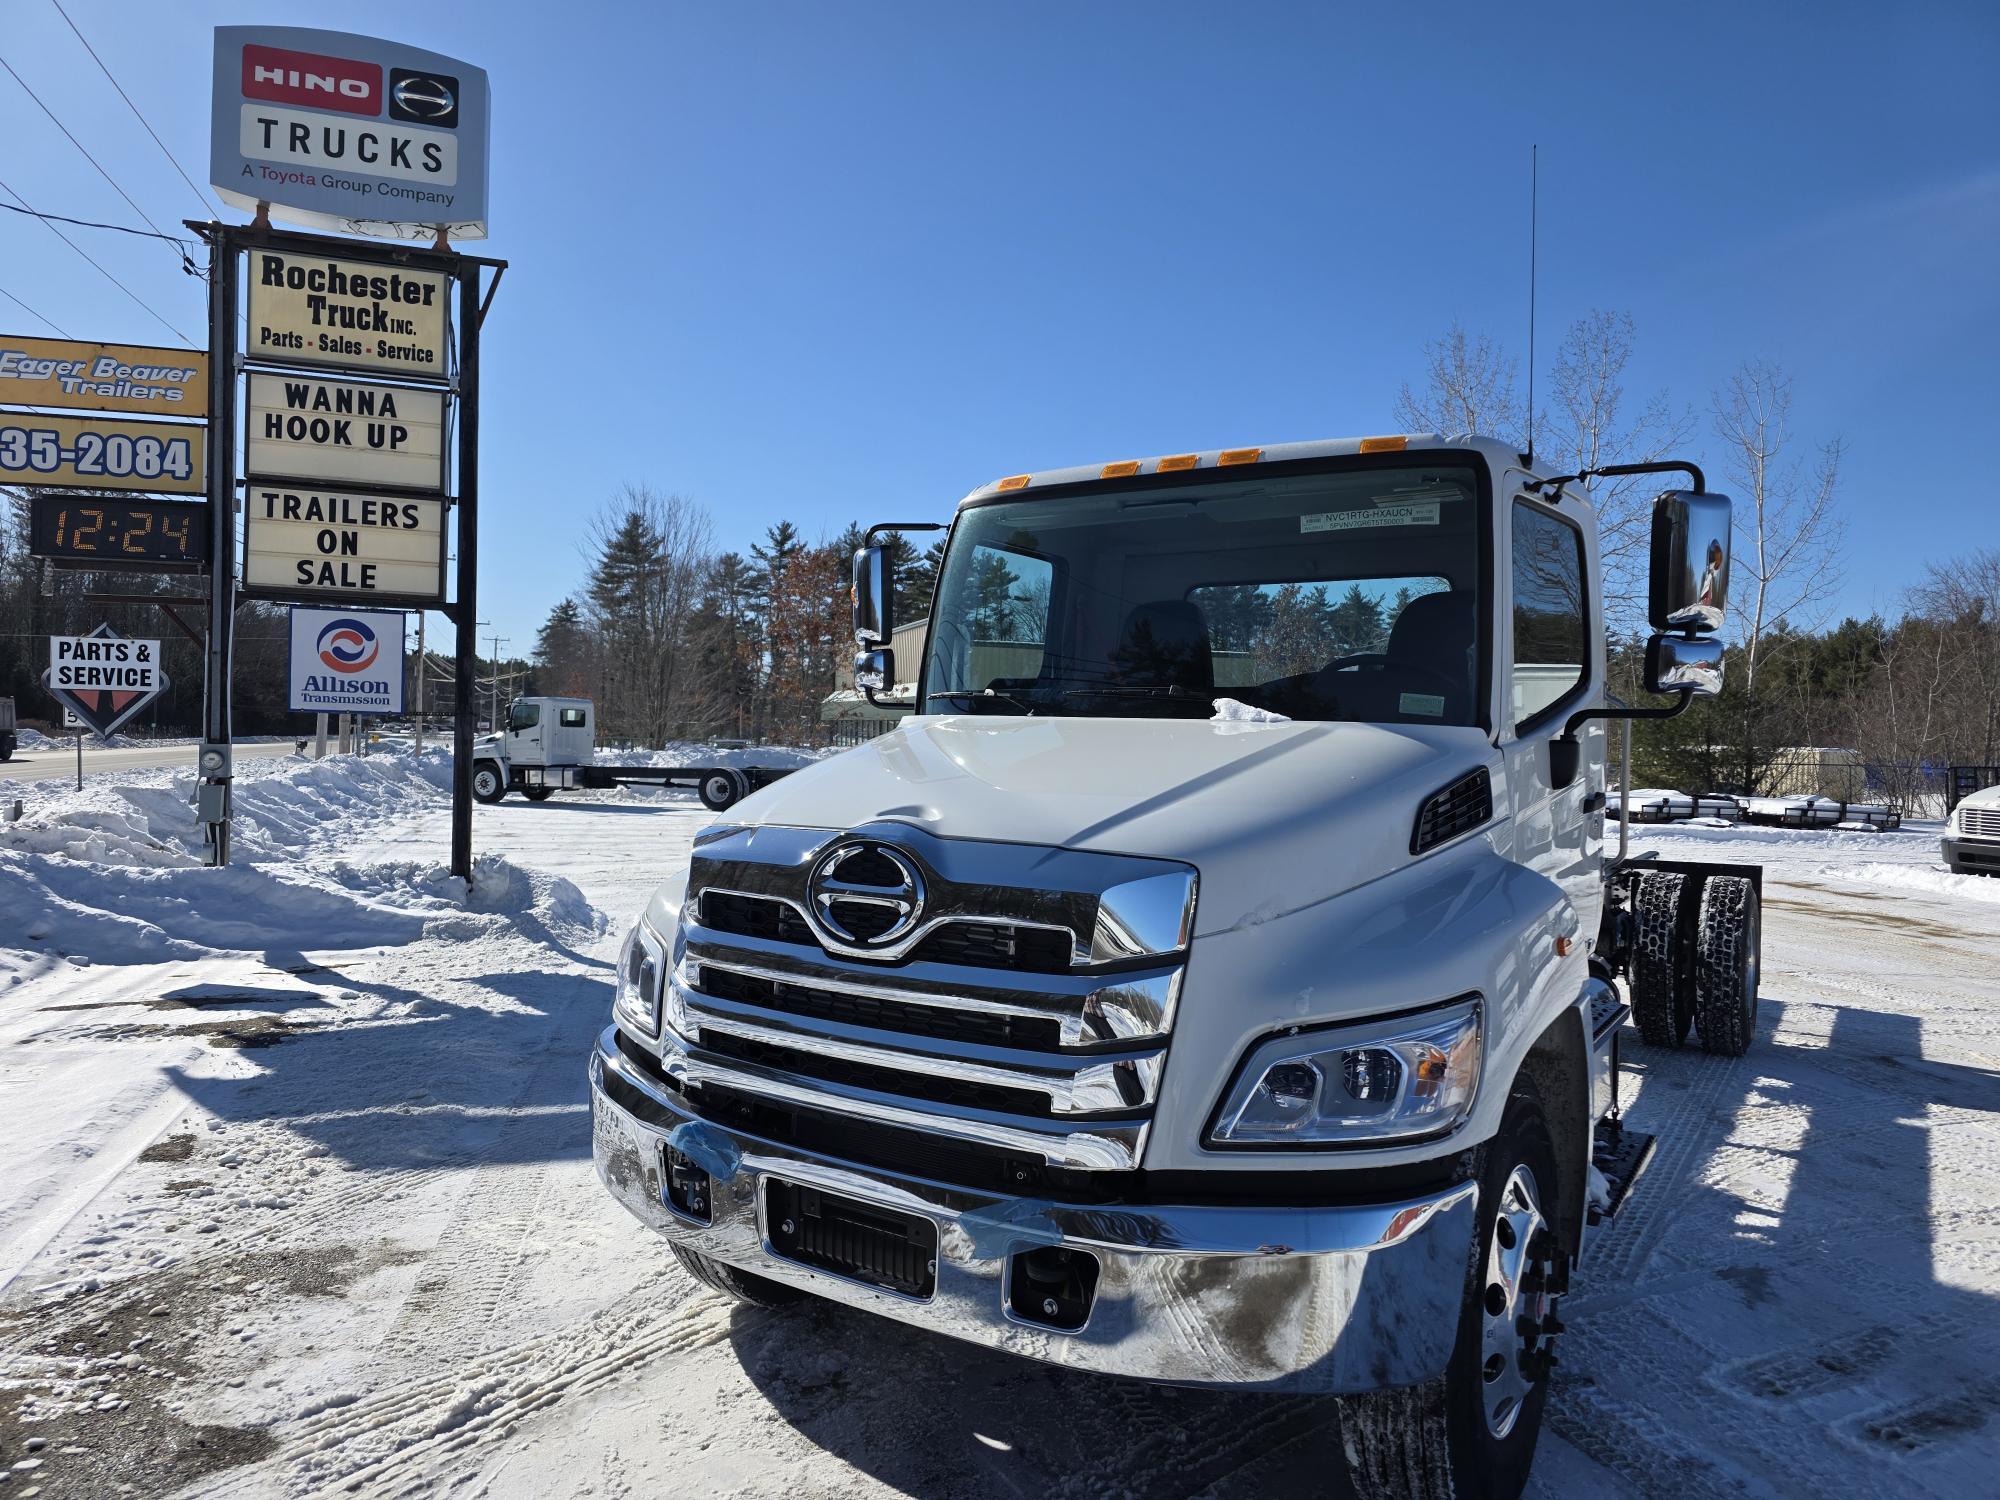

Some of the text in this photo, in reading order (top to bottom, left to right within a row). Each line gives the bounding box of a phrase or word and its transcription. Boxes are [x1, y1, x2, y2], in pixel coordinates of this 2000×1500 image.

[254, 65, 370, 98] HINO
[257, 117, 443, 173] TRUCKS
[241, 164, 454, 207] A Toyota Group Company
[262, 254, 436, 306] Rochester
[307, 294, 417, 336] Truck INC.
[261, 326, 434, 363] Parts Sales Service
[0, 350, 198, 383] Eager Beaver
[58, 376, 184, 402] Trailers
[284, 382, 397, 418] WANNA
[265, 413, 408, 450] HOOK UP
[262, 492, 419, 529] TRAILERS
[55, 509, 190, 552] 12:24
[317, 529, 358, 556] ON
[296, 559, 377, 589] SALE
[59, 641, 150, 662] PARTS &
[58, 666, 152, 686] SERVICE
[301, 675, 390, 694] Allison
[301, 693, 390, 705] Transmission
